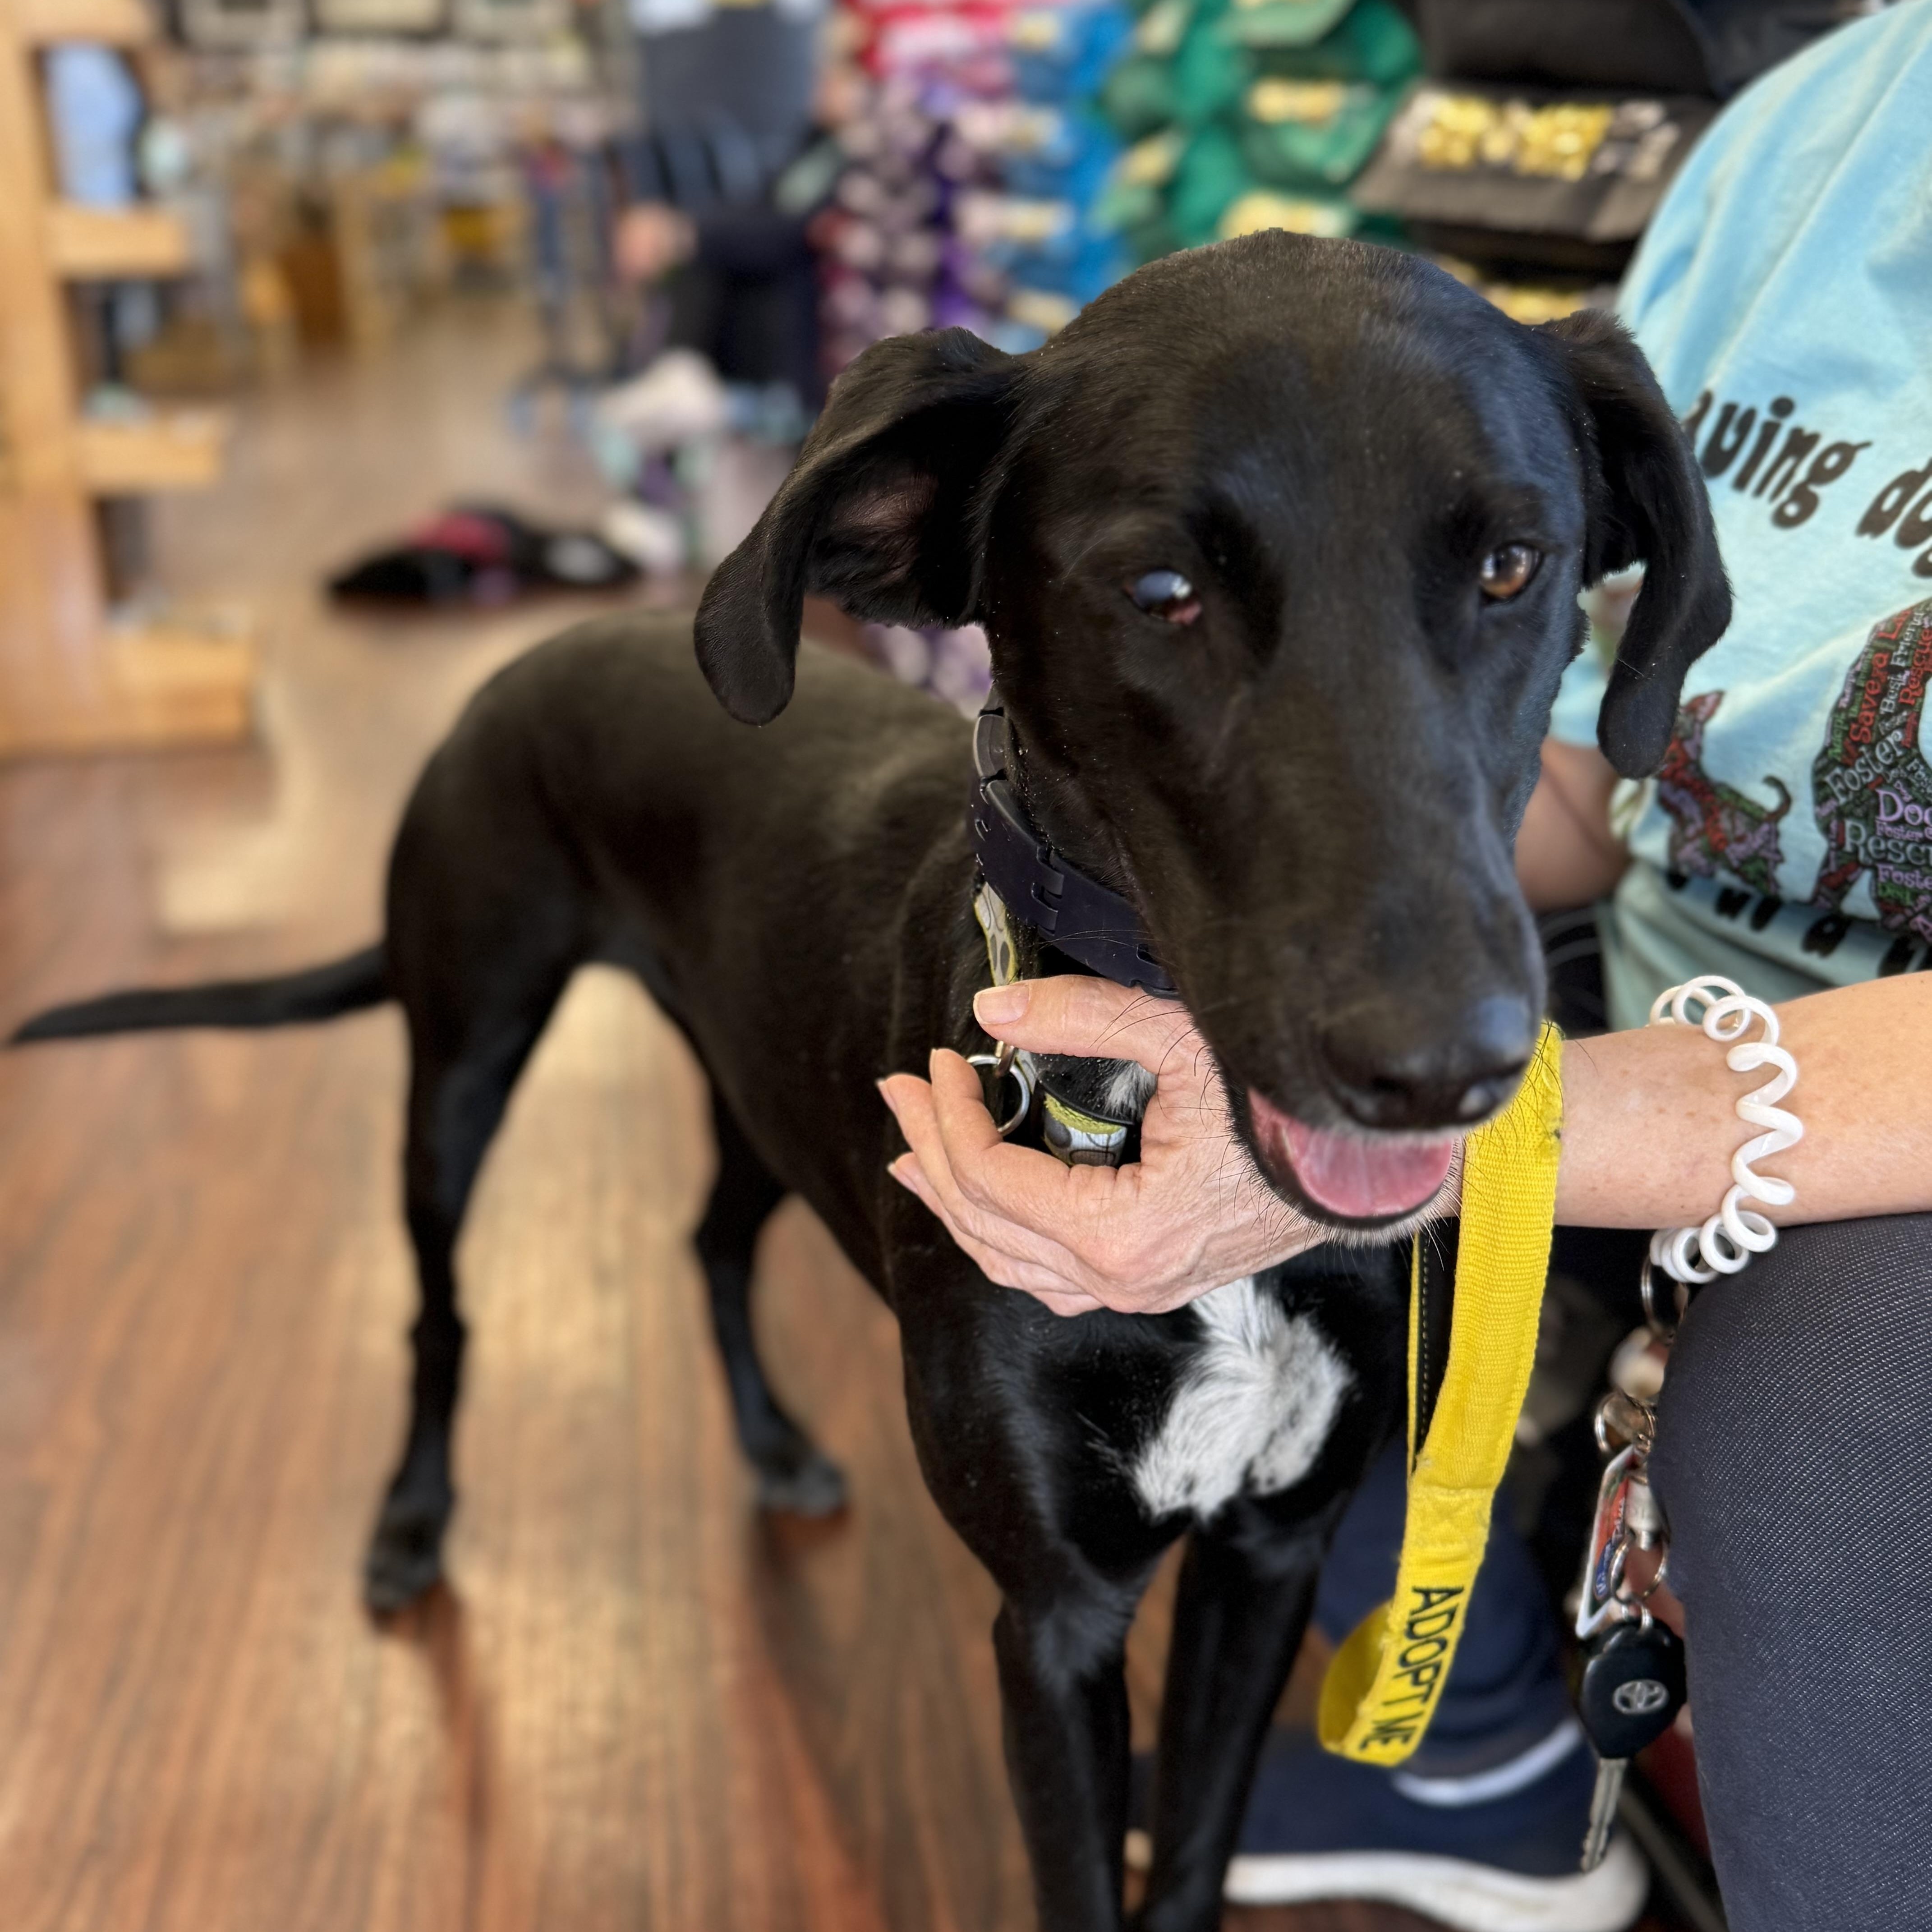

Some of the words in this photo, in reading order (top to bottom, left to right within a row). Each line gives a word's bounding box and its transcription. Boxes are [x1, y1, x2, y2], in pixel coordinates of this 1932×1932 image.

[1681, 388, 1872, 529] ving
[1898, 628, 1932, 705] Rescue
[1850, 680, 1881, 743] Save
[1824, 730, 1903, 804] Foster
[1876, 819, 1923, 842] Foster
[1382, 1586, 1464, 1706] ADOPT
